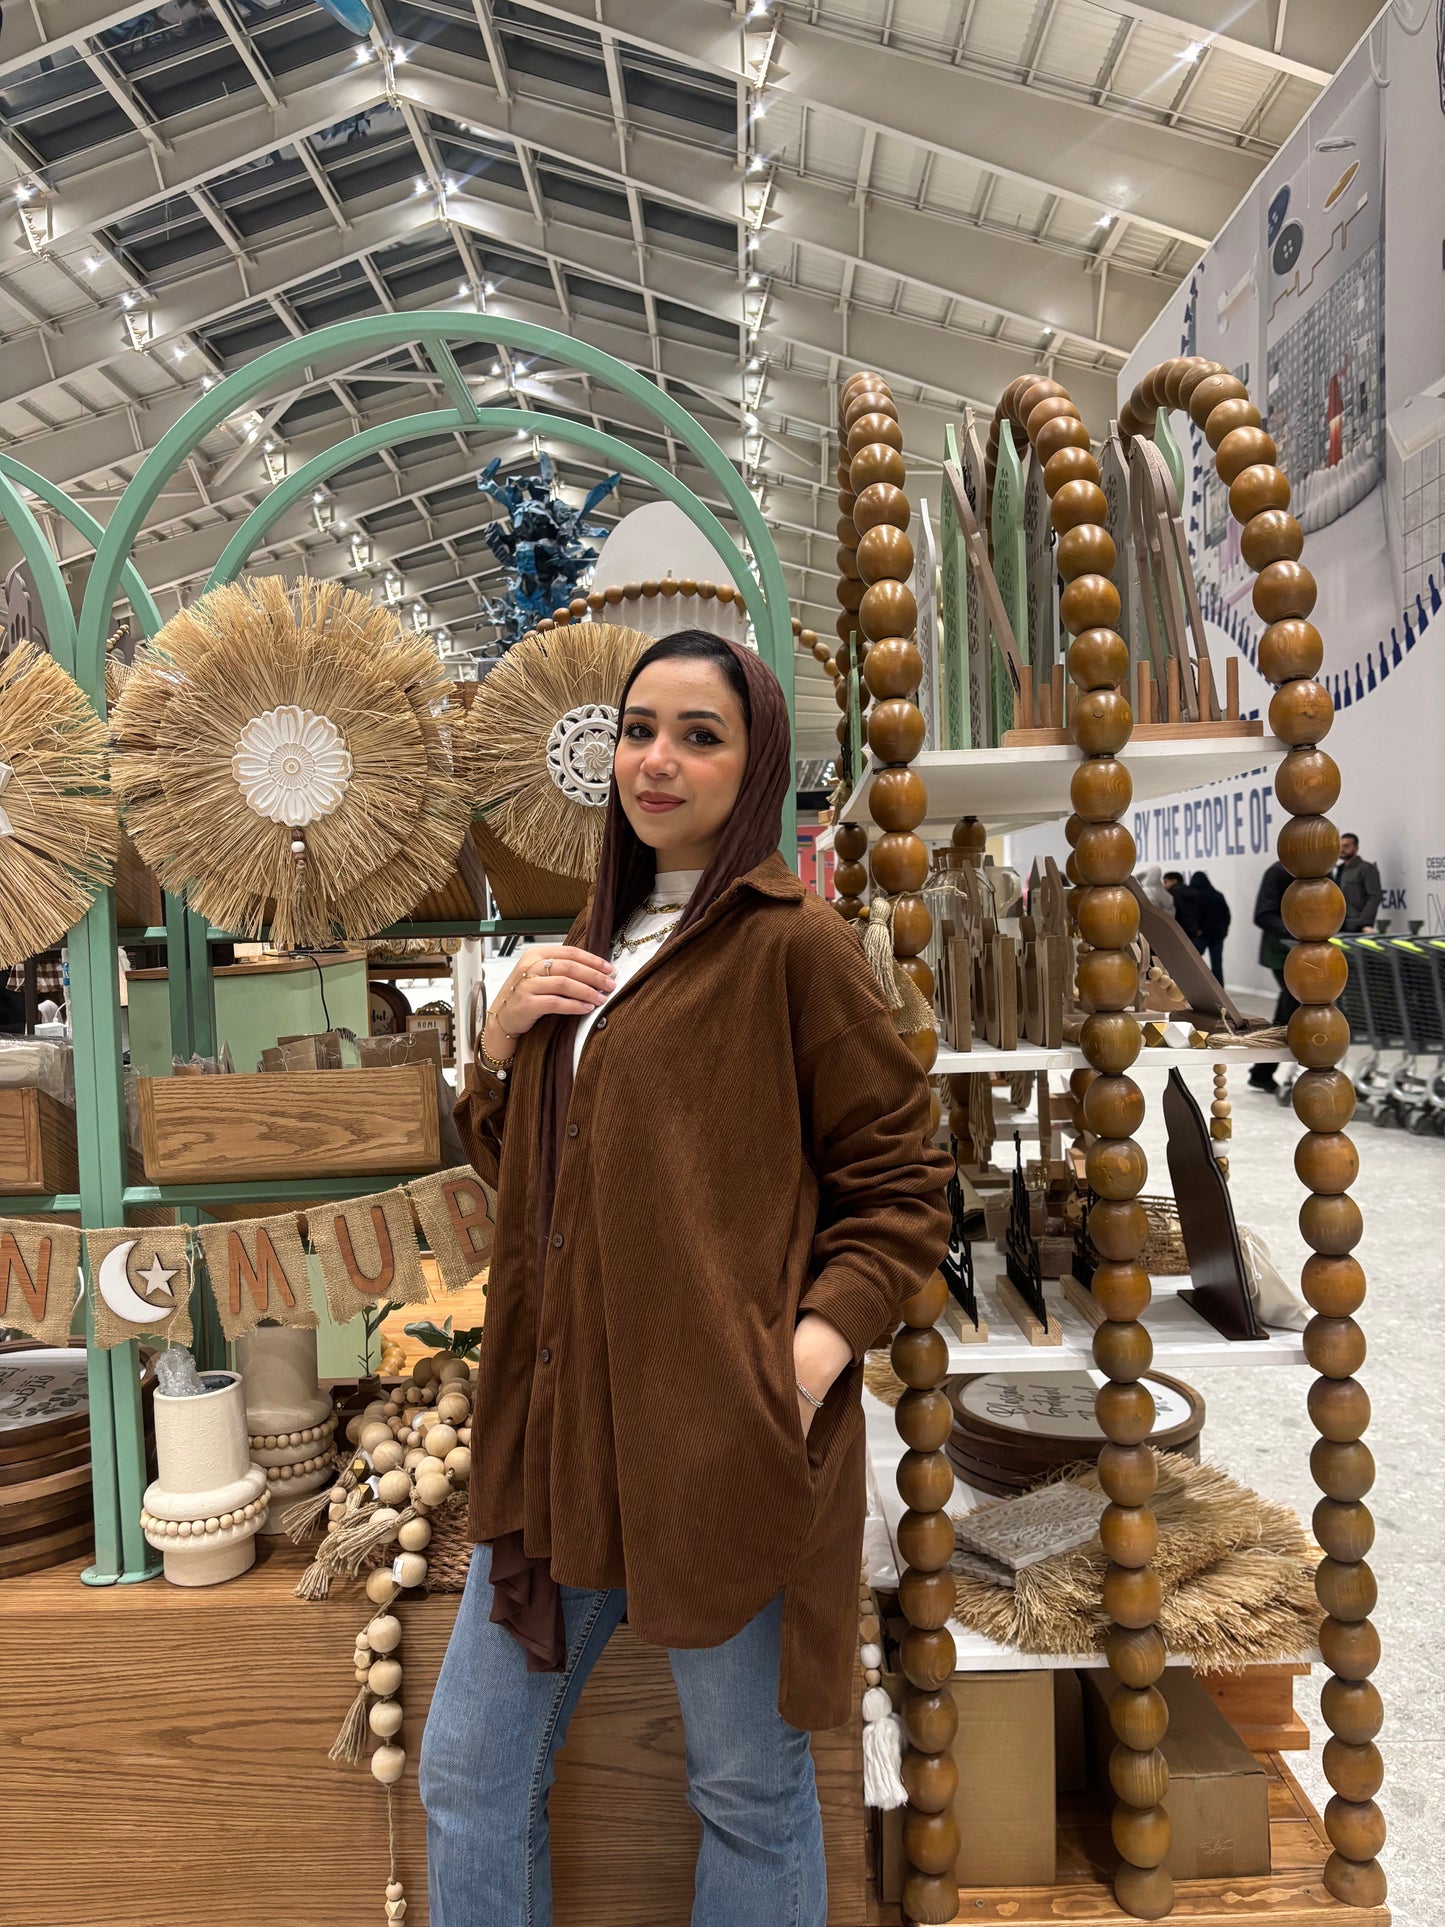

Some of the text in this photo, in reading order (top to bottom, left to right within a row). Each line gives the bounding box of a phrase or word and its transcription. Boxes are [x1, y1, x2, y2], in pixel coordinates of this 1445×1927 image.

[1134, 786, 1273, 862] BY THE PEOPLE OF
[417, 1021, 437, 1029] HOME
